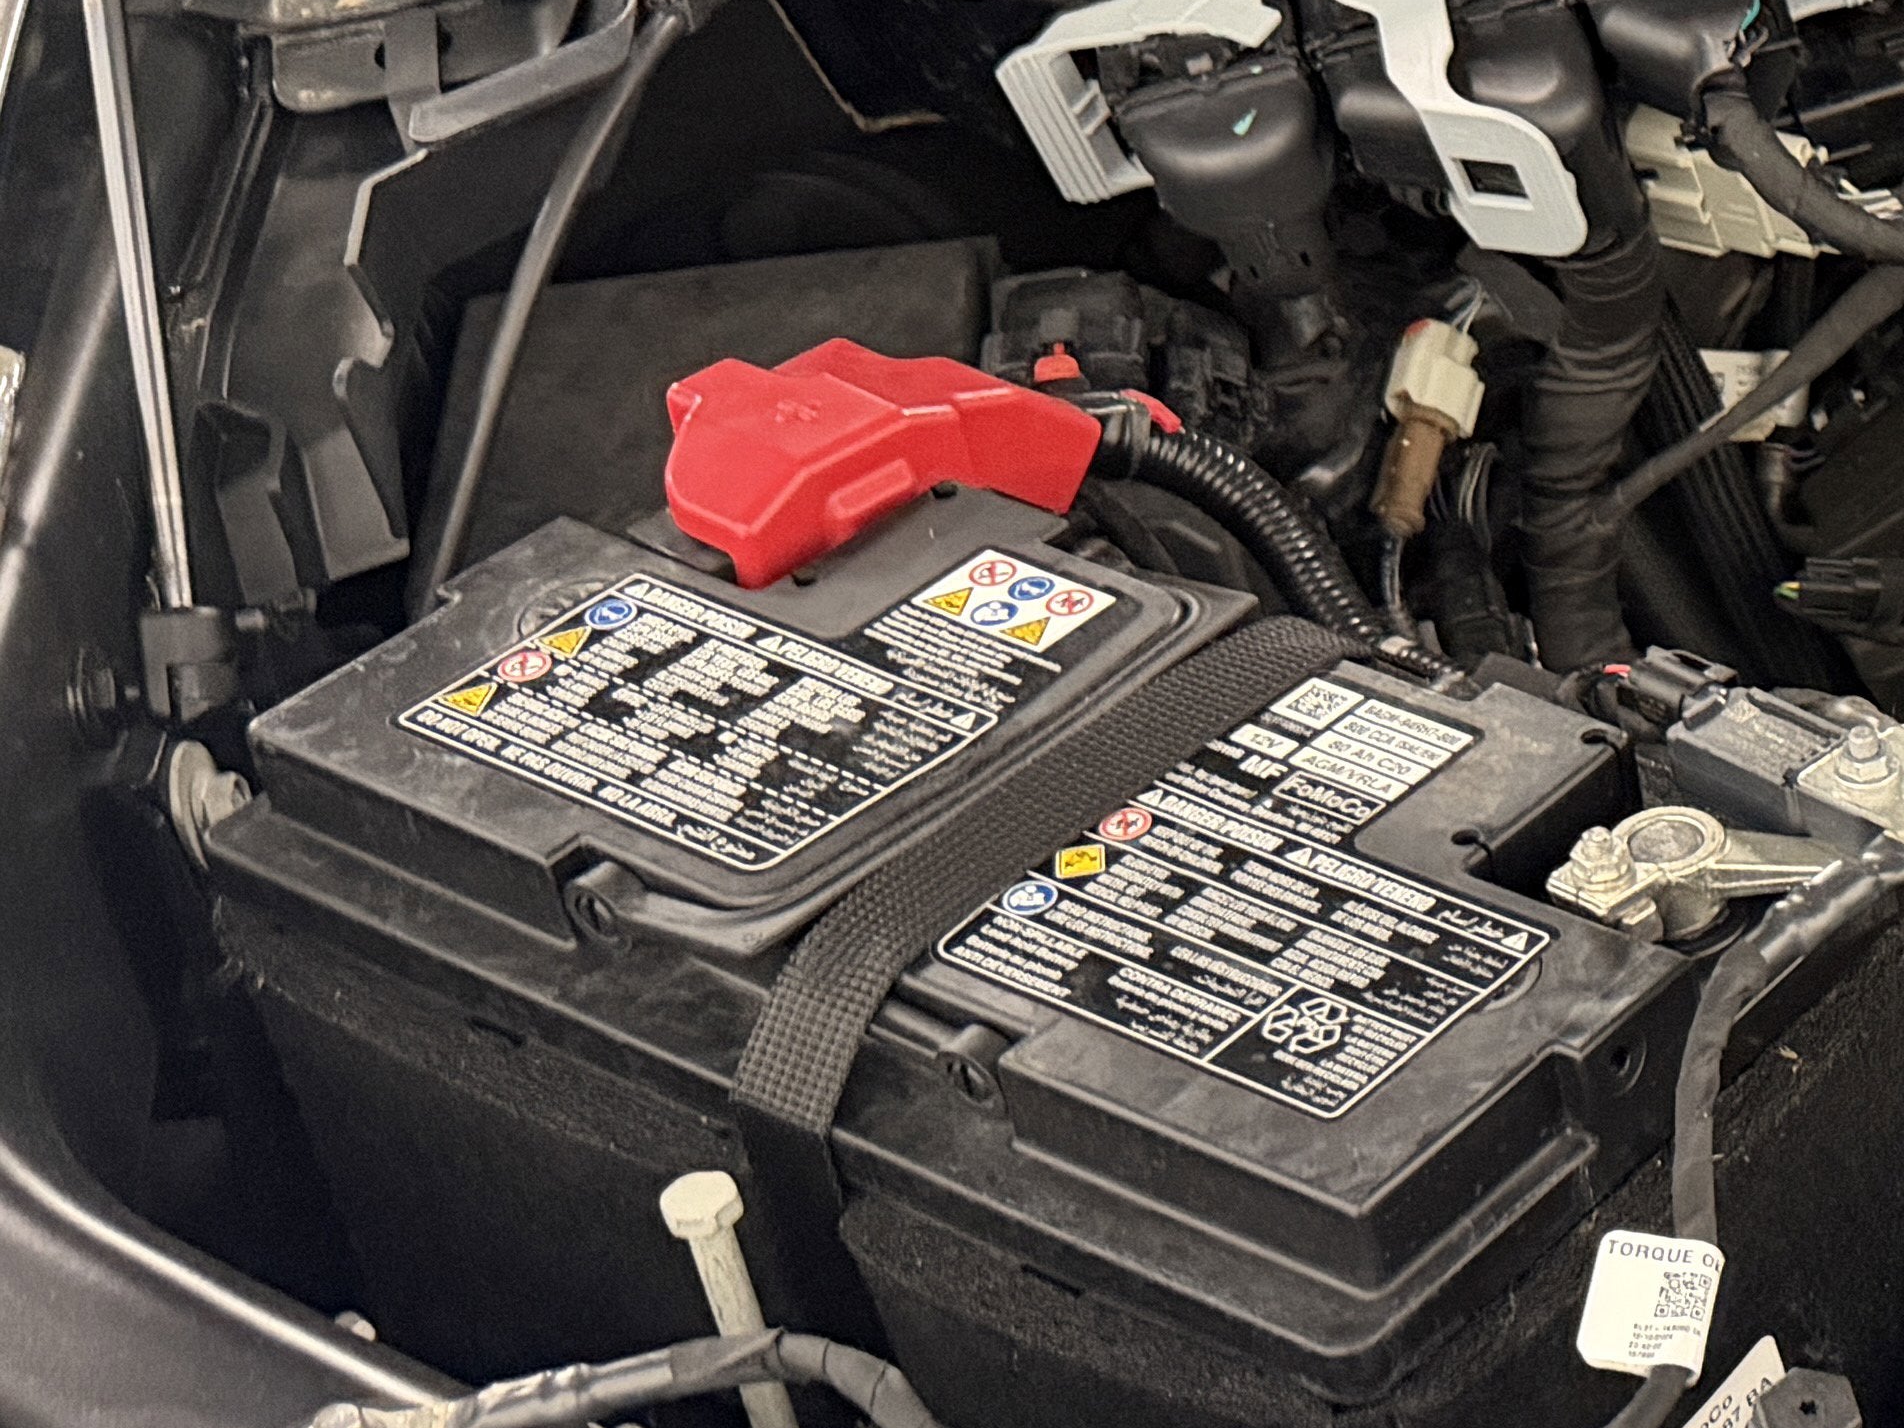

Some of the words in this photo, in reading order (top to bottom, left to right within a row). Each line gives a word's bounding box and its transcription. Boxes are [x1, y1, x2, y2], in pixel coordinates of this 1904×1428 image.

[1250, 733, 1283, 749] 12V
[1239, 755, 1289, 779] MF
[1352, 748, 1377, 763] Ah
[1302, 755, 1393, 794] AGM/VRLA
[1282, 776, 1373, 819] FoMoCo
[1609, 1239, 1694, 1263] TORQUE
